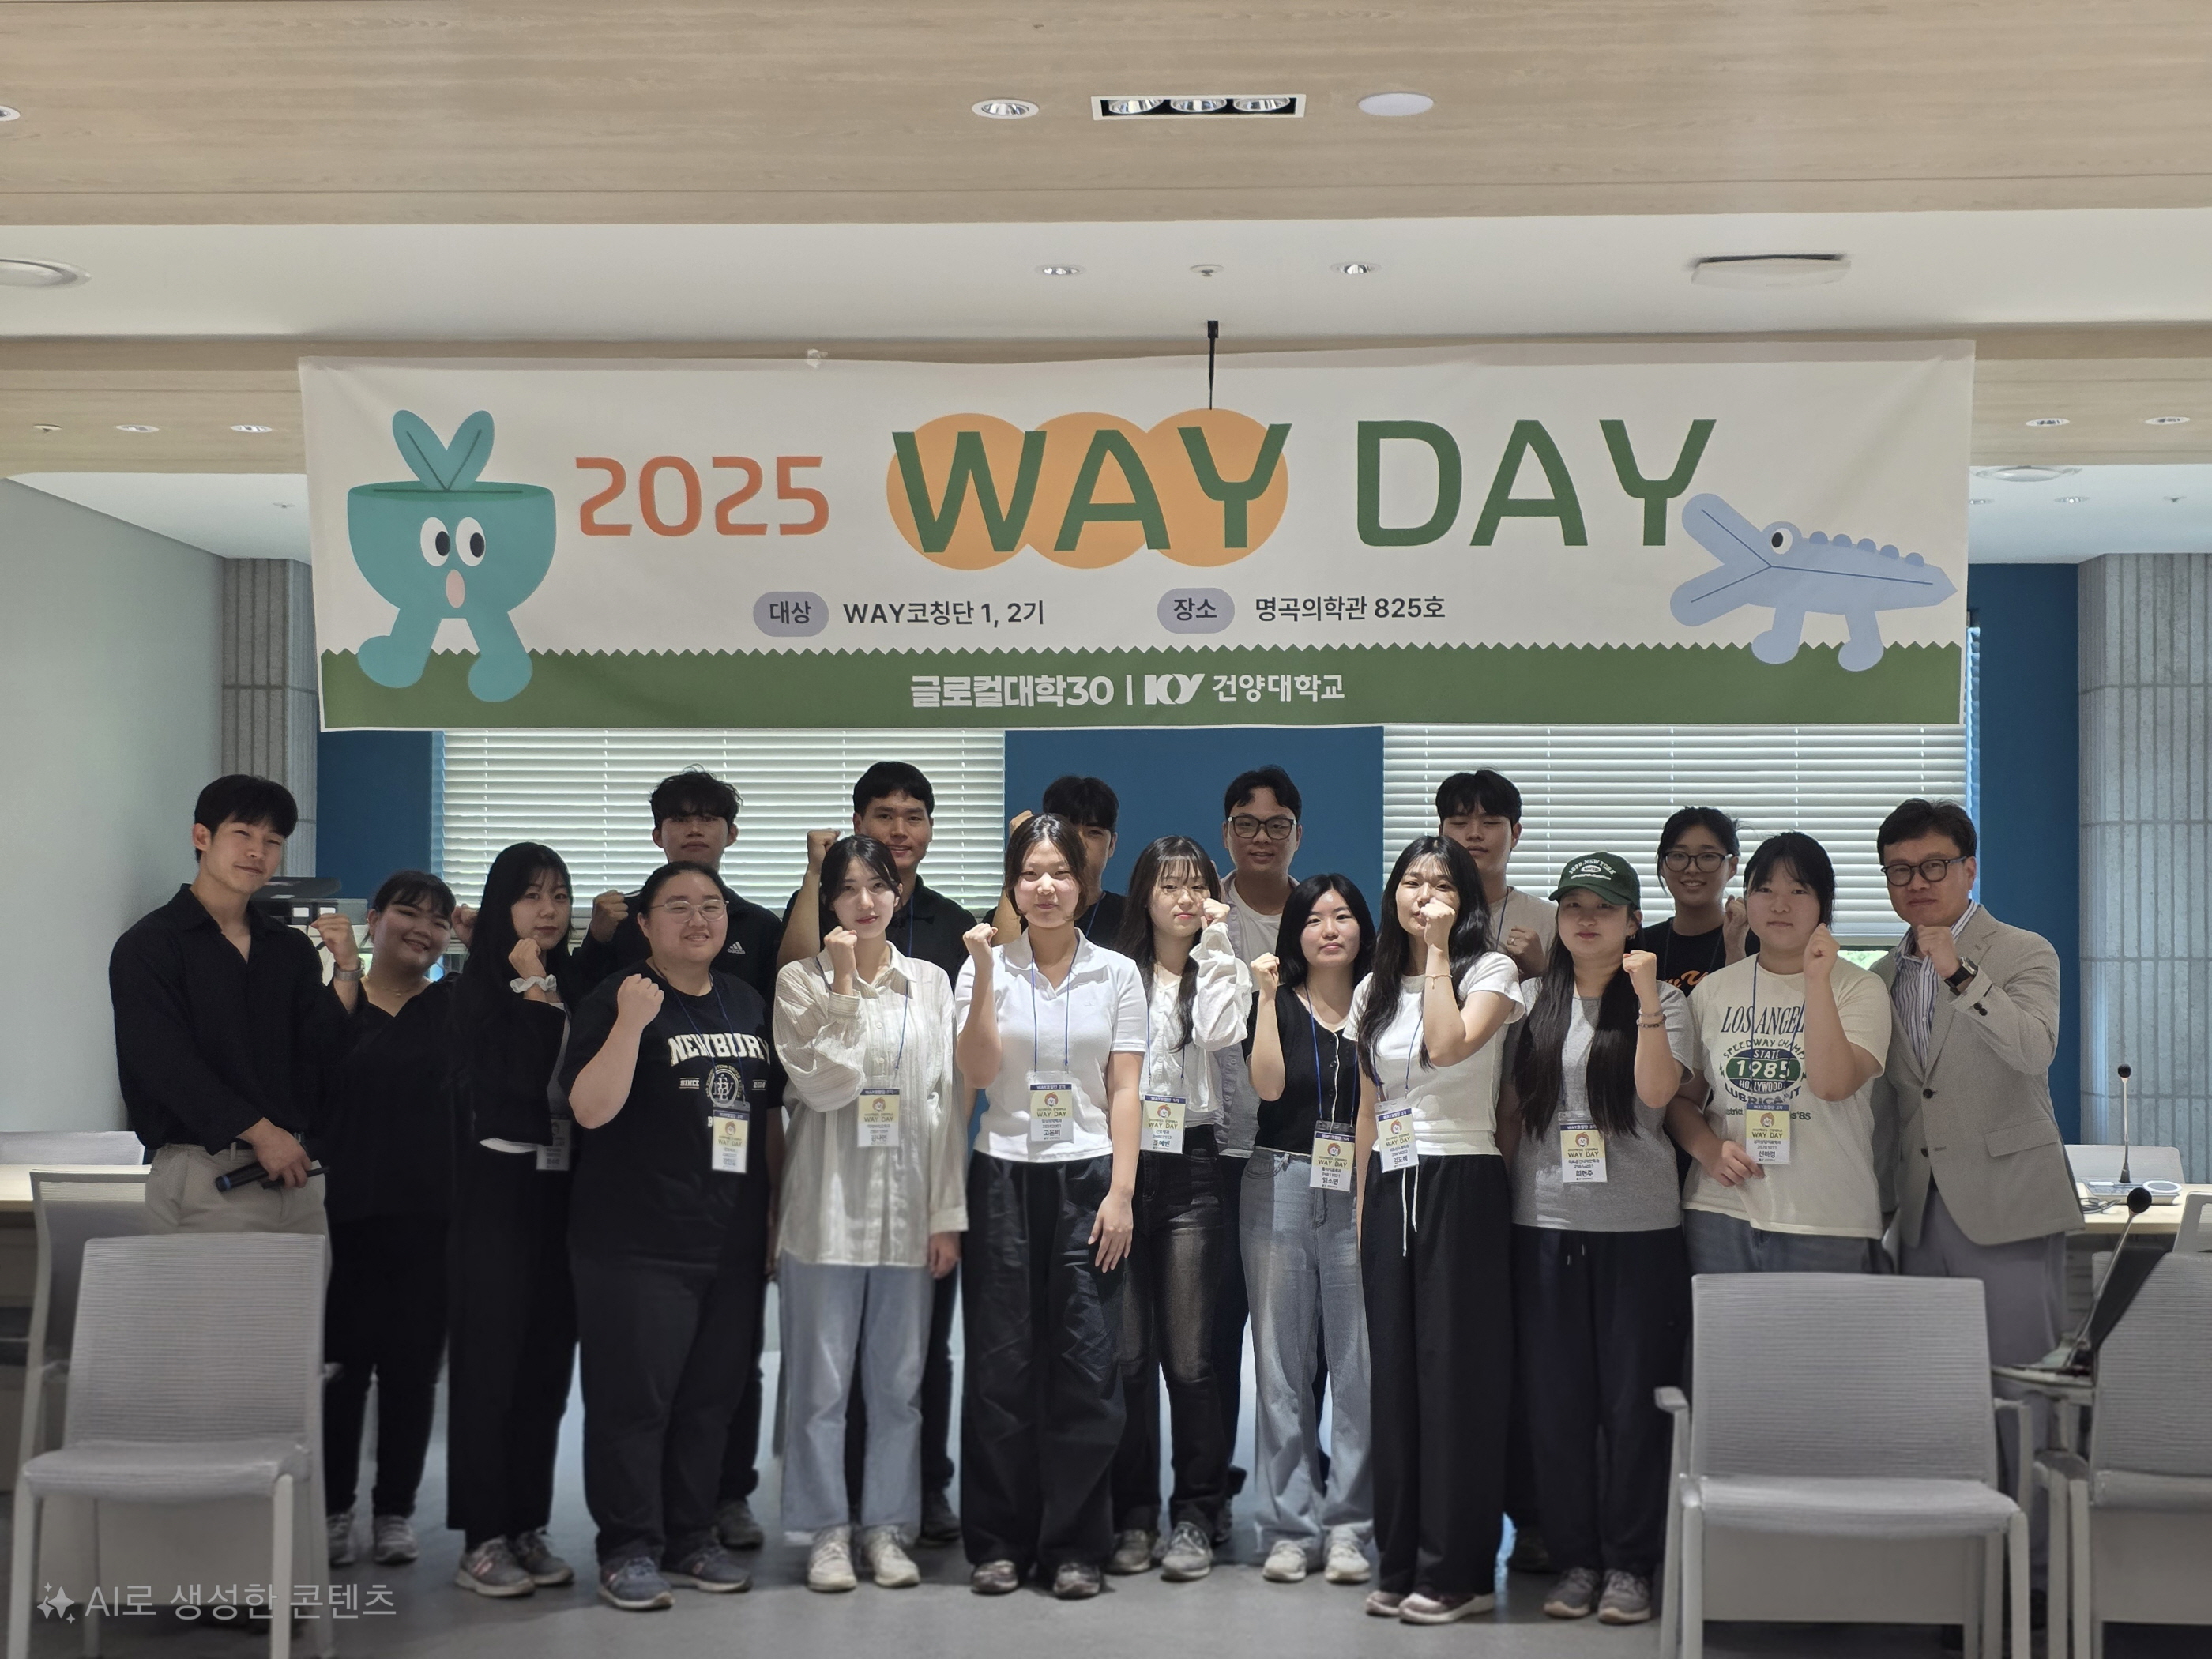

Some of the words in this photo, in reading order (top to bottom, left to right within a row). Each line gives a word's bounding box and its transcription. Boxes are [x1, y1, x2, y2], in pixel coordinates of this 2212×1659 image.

[575, 456, 830, 536] 2025
[890, 423, 1292, 554] WAY
[1357, 419, 1716, 547] DAY
[769, 600, 812, 624] 대상
[843, 600, 974, 625] WAY코칭단
[980, 603, 999, 628] 1,
[1007, 600, 1044, 624] 2기
[1173, 598, 1217, 621] 장소
[1255, 596, 1367, 622] 명곡의학관
[1374, 596, 1446, 619] 825호
[911, 675, 1114, 708] 글로컬대학30
[1212, 674, 1345, 702] 건양대학교
[1600, 860, 1616, 875] YORK
[1721, 1006, 1753, 1033] LOS
[1754, 1006, 1805, 1036] ANGEL
[668, 1033, 770, 1066] NEWBURY
[1723, 1038, 1775, 1059] SPEEDWAY
[1754, 1049, 1781, 1059] STATE
[1736, 1059, 1790, 1078] 1985
[1739, 1079, 1783, 1093] HOLYWOOD
